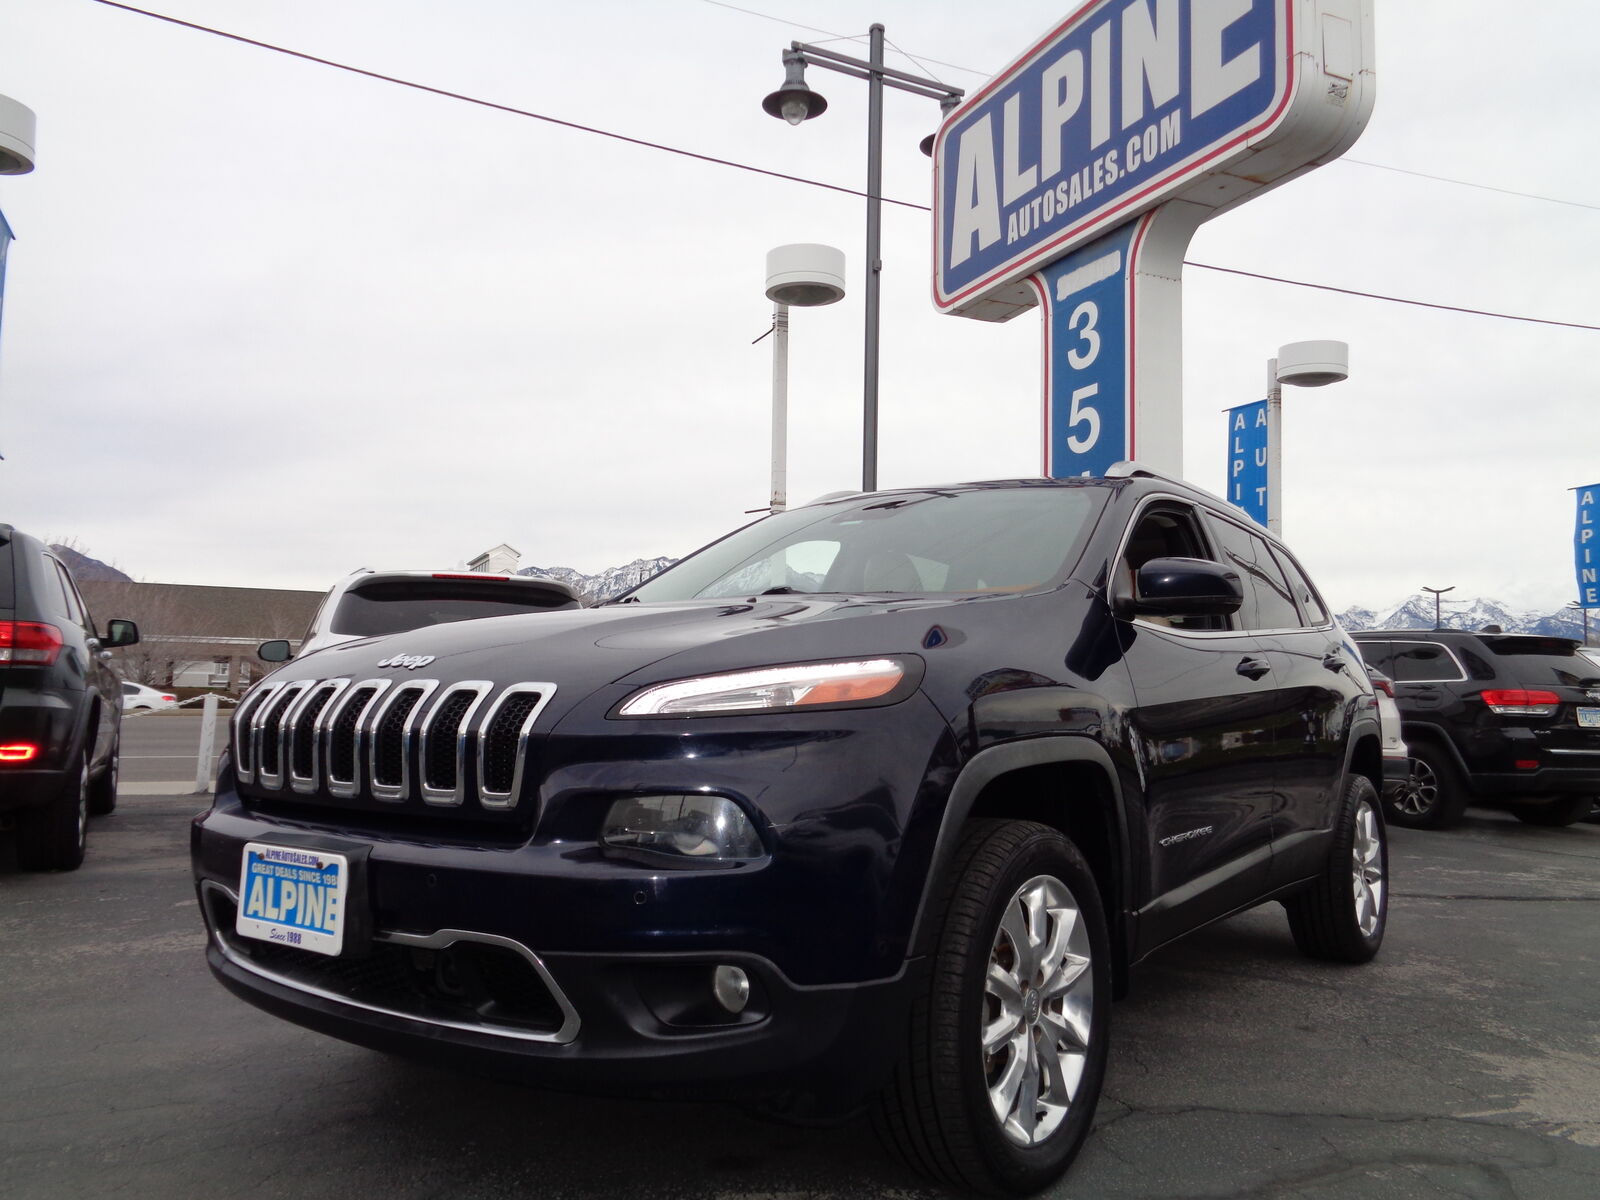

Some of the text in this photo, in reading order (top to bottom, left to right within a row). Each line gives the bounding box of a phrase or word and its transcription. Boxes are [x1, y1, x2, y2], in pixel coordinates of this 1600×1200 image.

[951, 0, 1261, 269] ALPINE
[1007, 109, 1181, 246] AUTOSALES.COM
[1581, 491, 1598, 603] ALPINE
[377, 653, 436, 671] Jeep
[1159, 825, 1213, 847] CHEROKEE
[252, 863, 273, 875] GREAT
[275, 867, 297, 880] DEALS
[299, 871, 321, 883] SINCE
[247, 875, 337, 931] ALPINE
[269, 928, 302, 944] Since 1988
